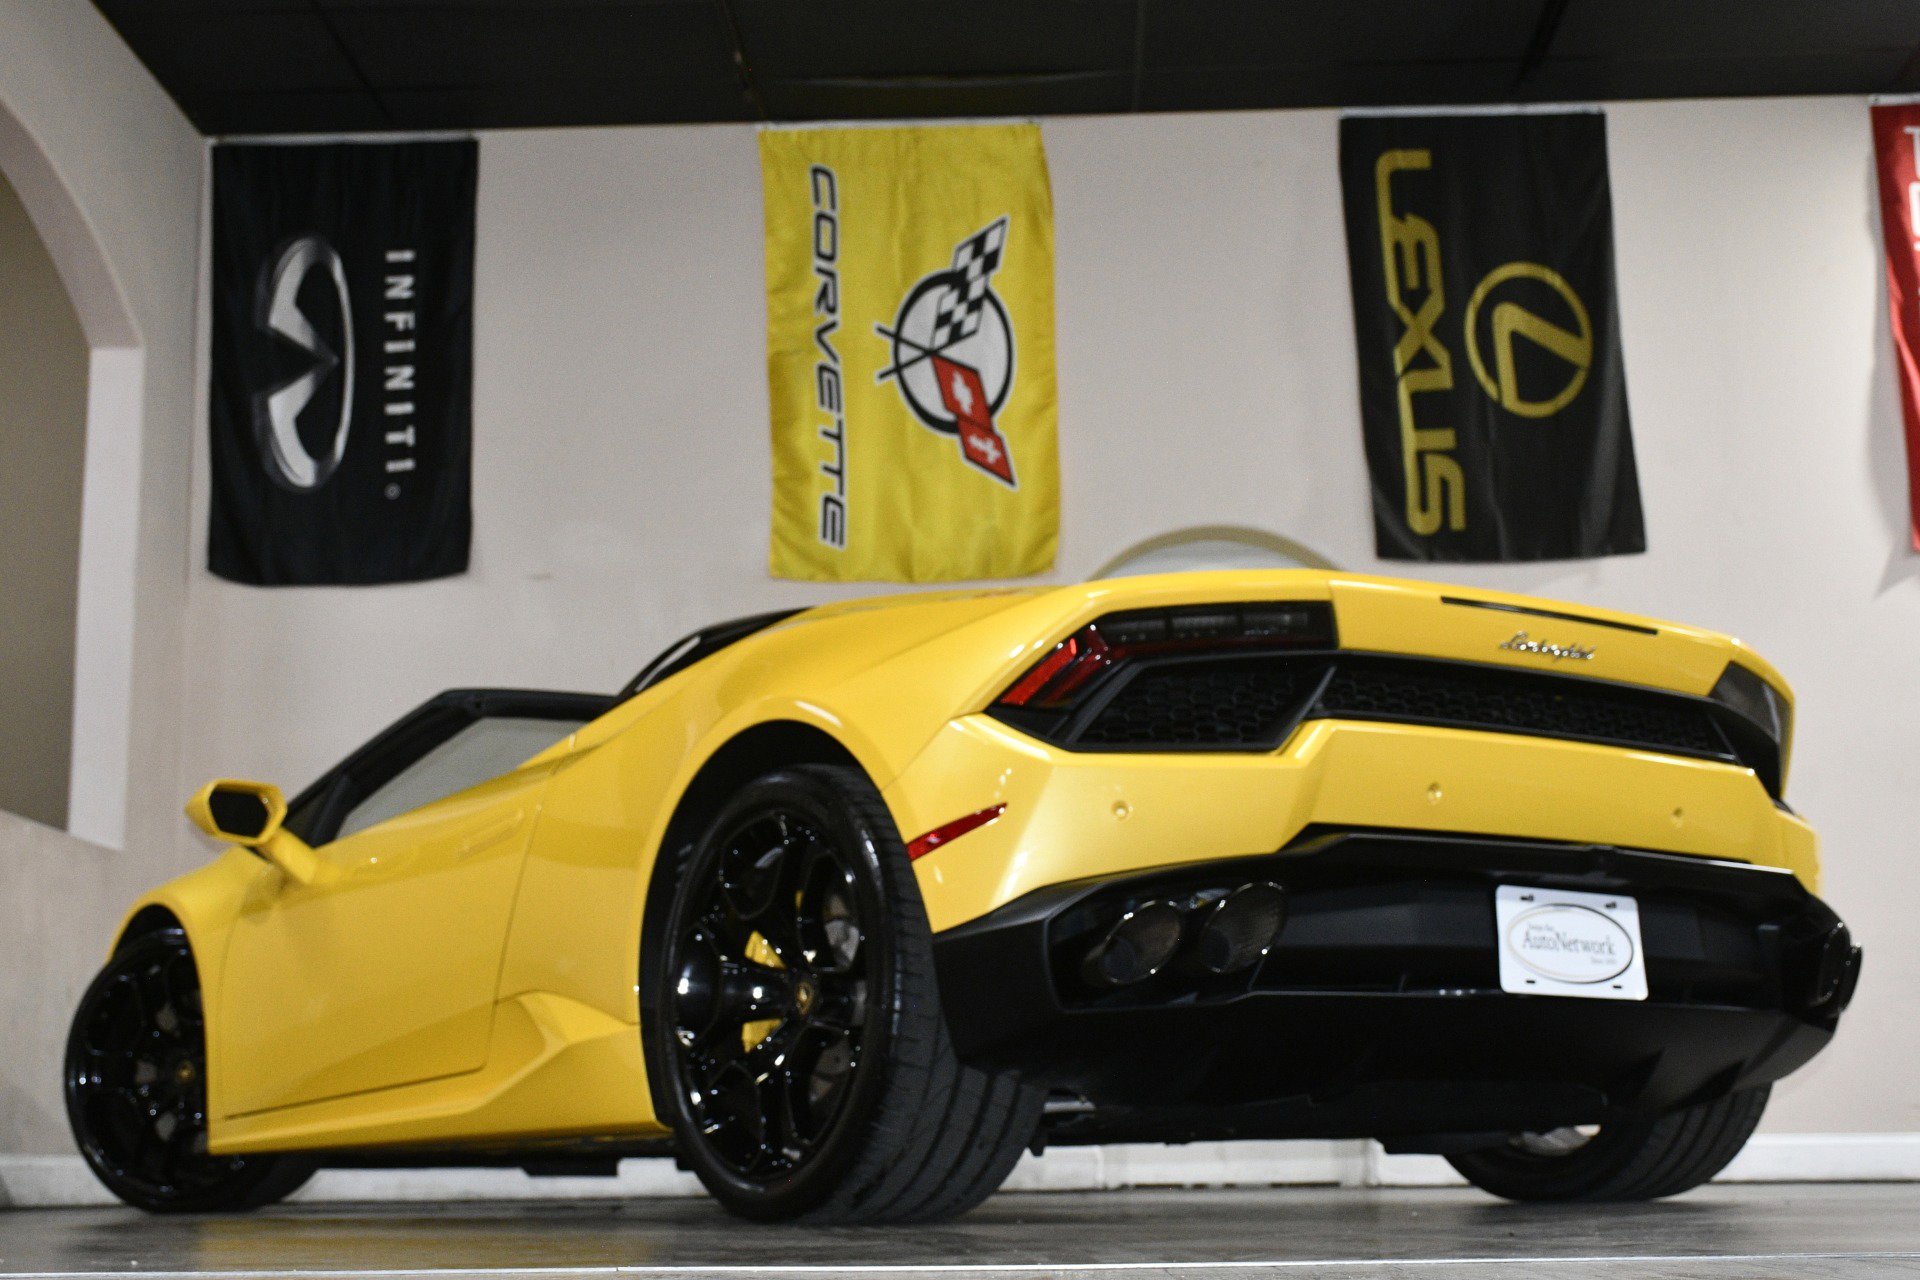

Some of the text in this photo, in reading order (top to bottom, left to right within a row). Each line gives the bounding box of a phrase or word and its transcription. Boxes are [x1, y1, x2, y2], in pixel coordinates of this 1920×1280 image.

[384, 249, 416, 474] INFINITI
[809, 163, 848, 550] CORVETTE
[1376, 148, 1467, 536] LEXUS
